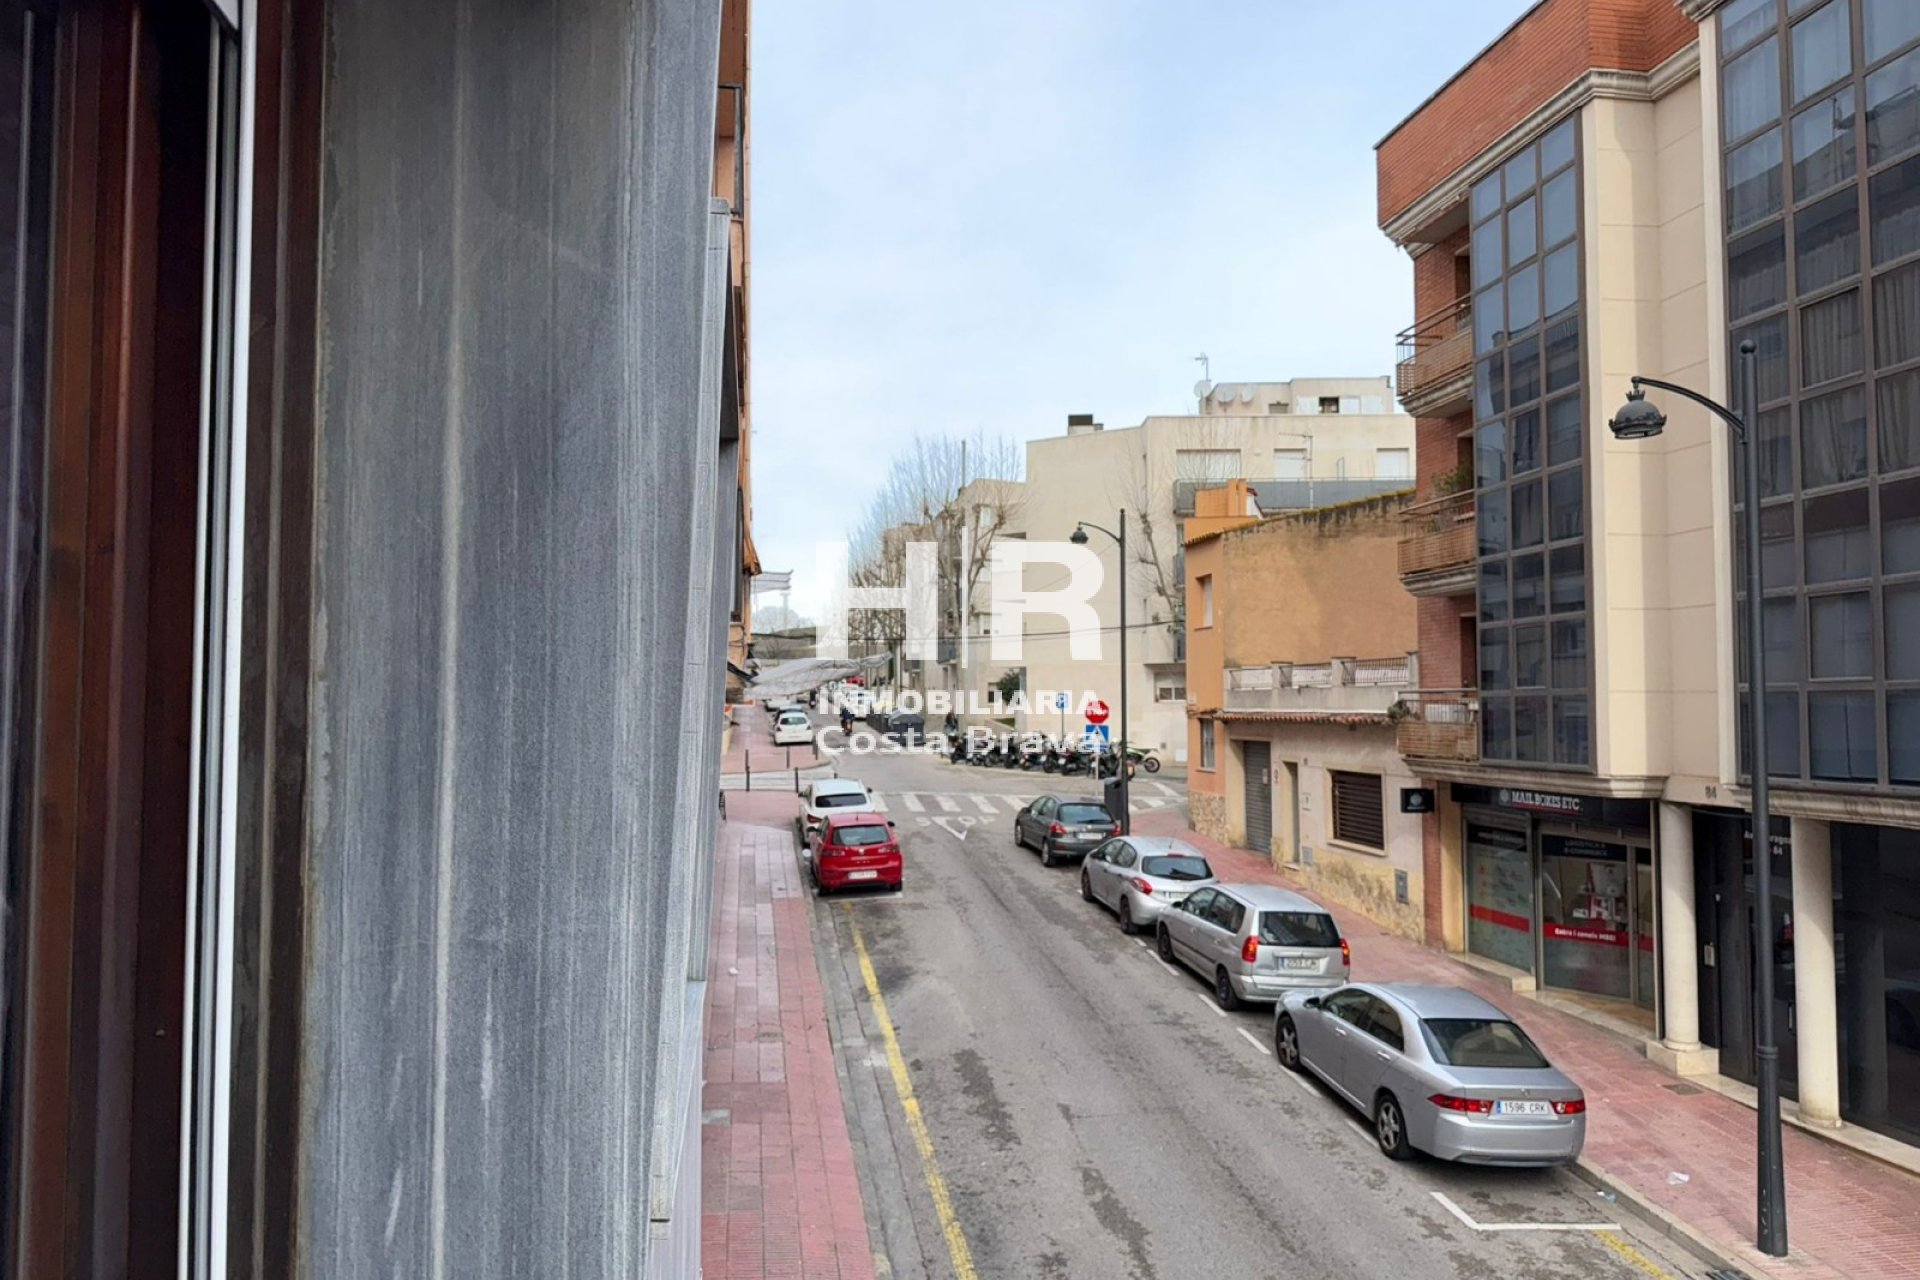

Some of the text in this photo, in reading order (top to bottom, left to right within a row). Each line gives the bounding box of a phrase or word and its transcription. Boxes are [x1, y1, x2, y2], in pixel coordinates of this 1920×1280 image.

[1511, 790, 1534, 804] MAIL
[1504, 1101, 1545, 1113] 1596 CRK
